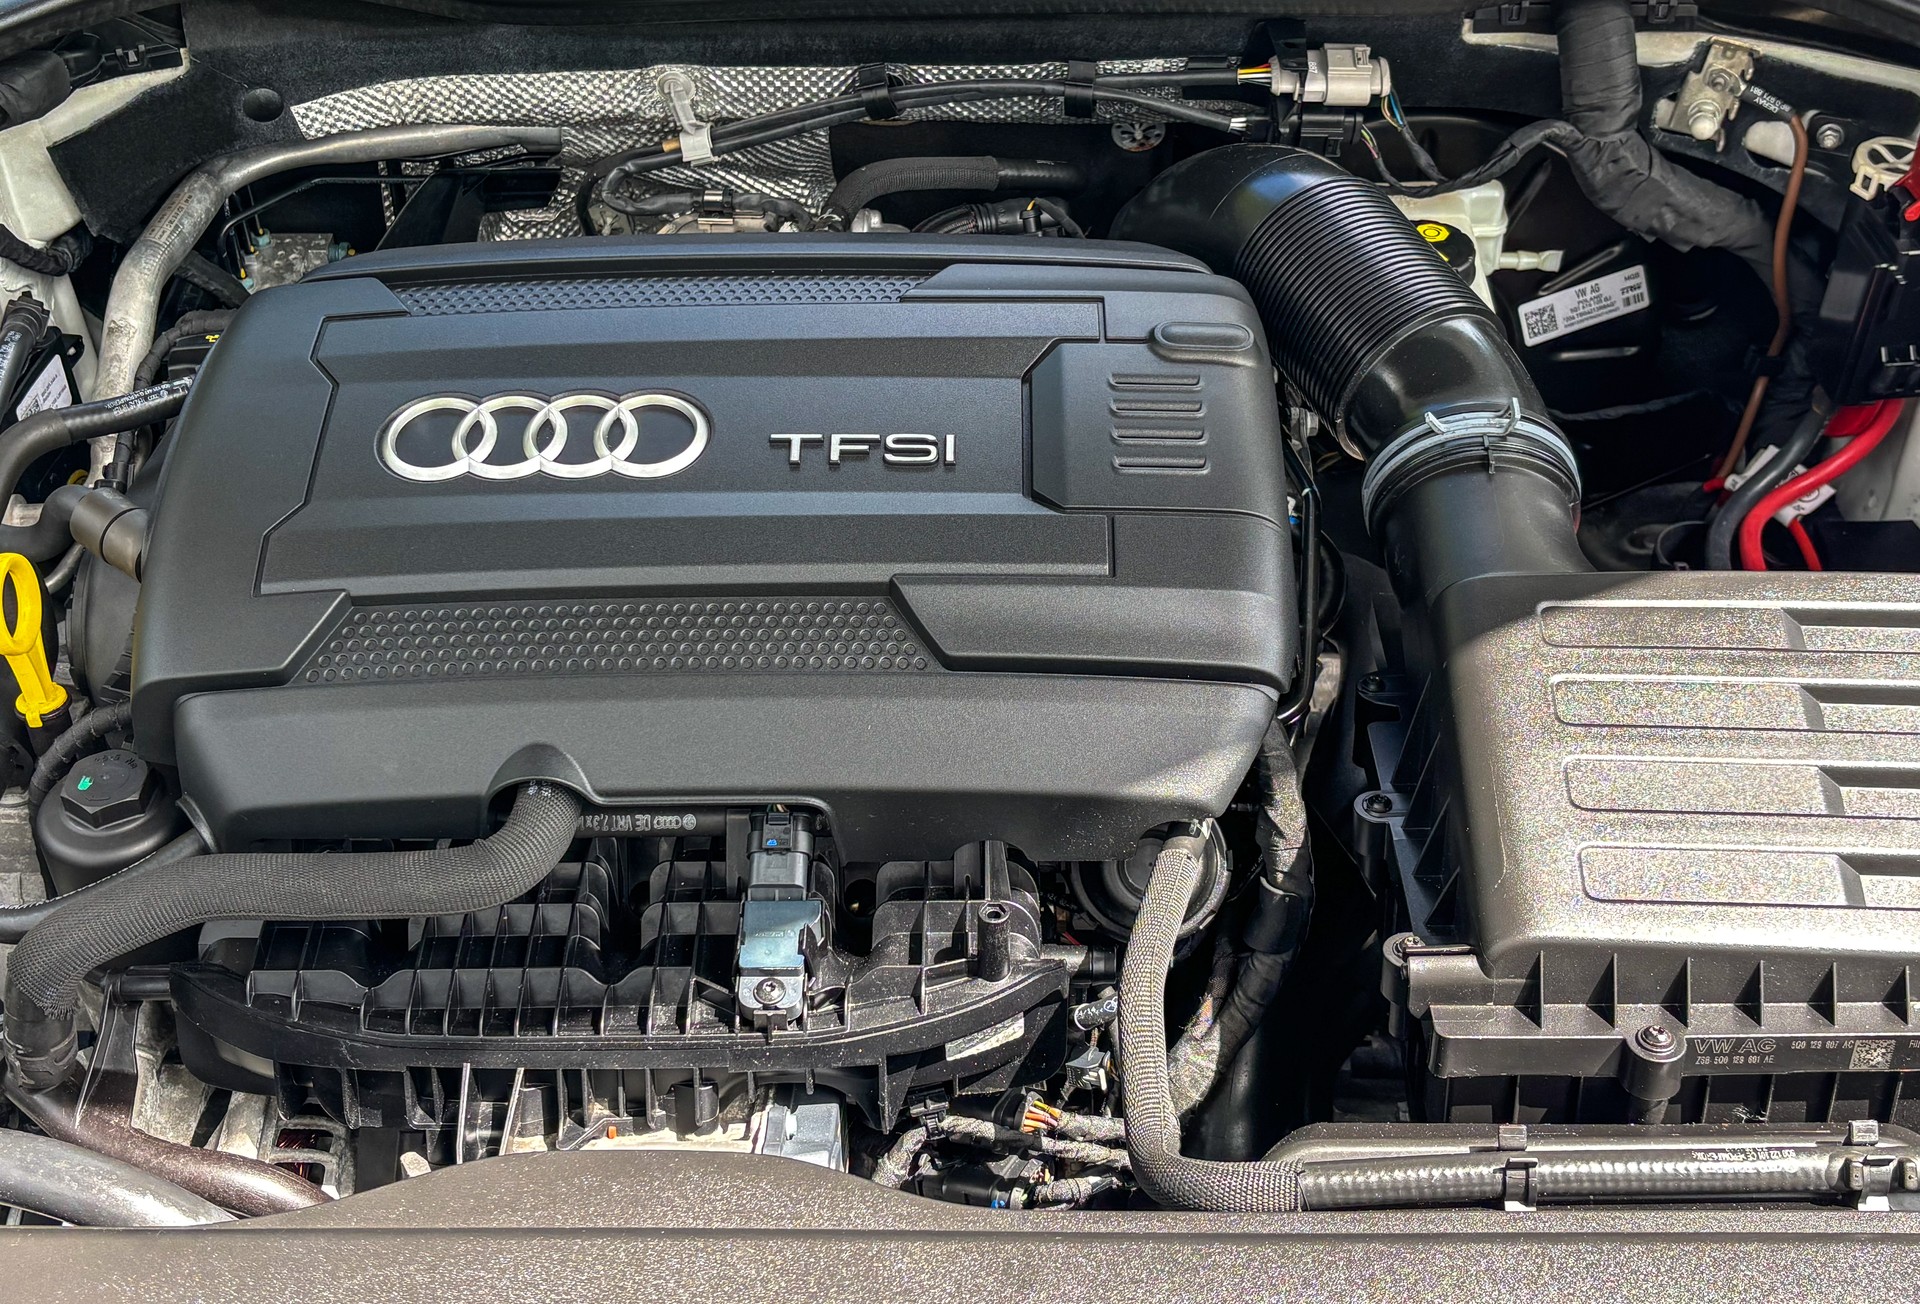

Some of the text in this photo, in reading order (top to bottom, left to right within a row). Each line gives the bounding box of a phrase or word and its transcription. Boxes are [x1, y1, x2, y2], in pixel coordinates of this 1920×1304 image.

[1575, 283, 1601, 300] VW AG
[769, 433, 957, 466] TFSI
[611, 814, 633, 831] VRT
[635, 814, 651, 831] DE
[1694, 1038, 1777, 1054] VW AG
